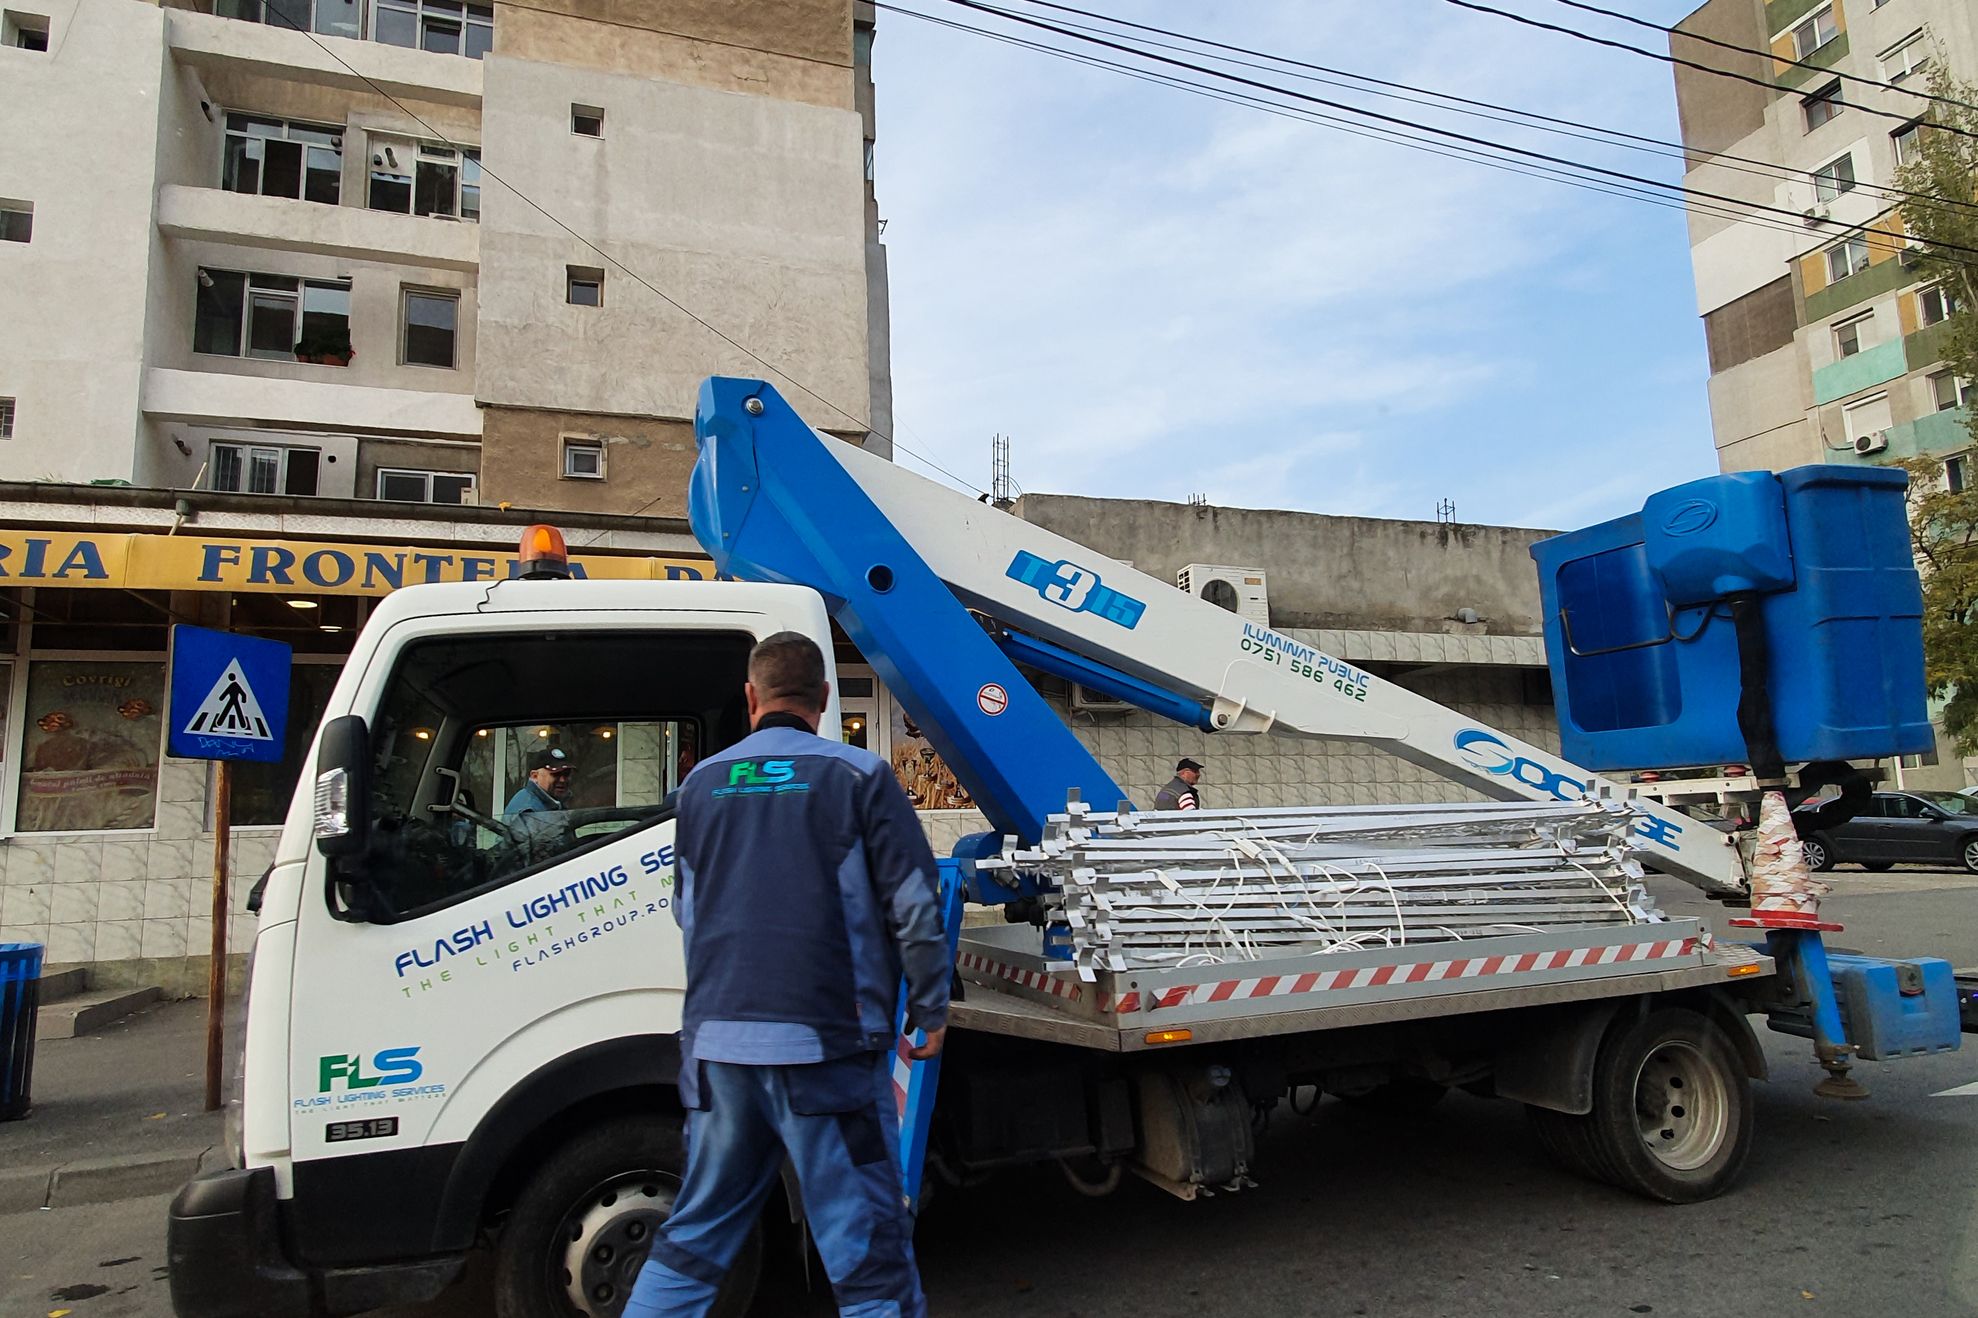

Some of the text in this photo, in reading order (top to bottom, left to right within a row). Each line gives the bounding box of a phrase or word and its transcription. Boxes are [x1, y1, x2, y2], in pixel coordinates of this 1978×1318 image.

[0, 539, 589, 588] IA FRONTE
[1240, 638, 1367, 702] 0751 586 462
[1243, 623, 1369, 688] ILUMINAT PUBLIC
[729, 760, 796, 785] FLS
[395, 919, 494, 978] FLASH
[505, 865, 628, 929] LIGHTING
[402, 890, 637, 998] THE LIGHT THAT
[512, 898, 669, 972] FLASHGROUP.RO
[294, 1084, 445, 1108] FLASH LIGHTING SERVICES
[319, 1046, 423, 1092] FLS
[331, 1119, 393, 1140] 35.13
